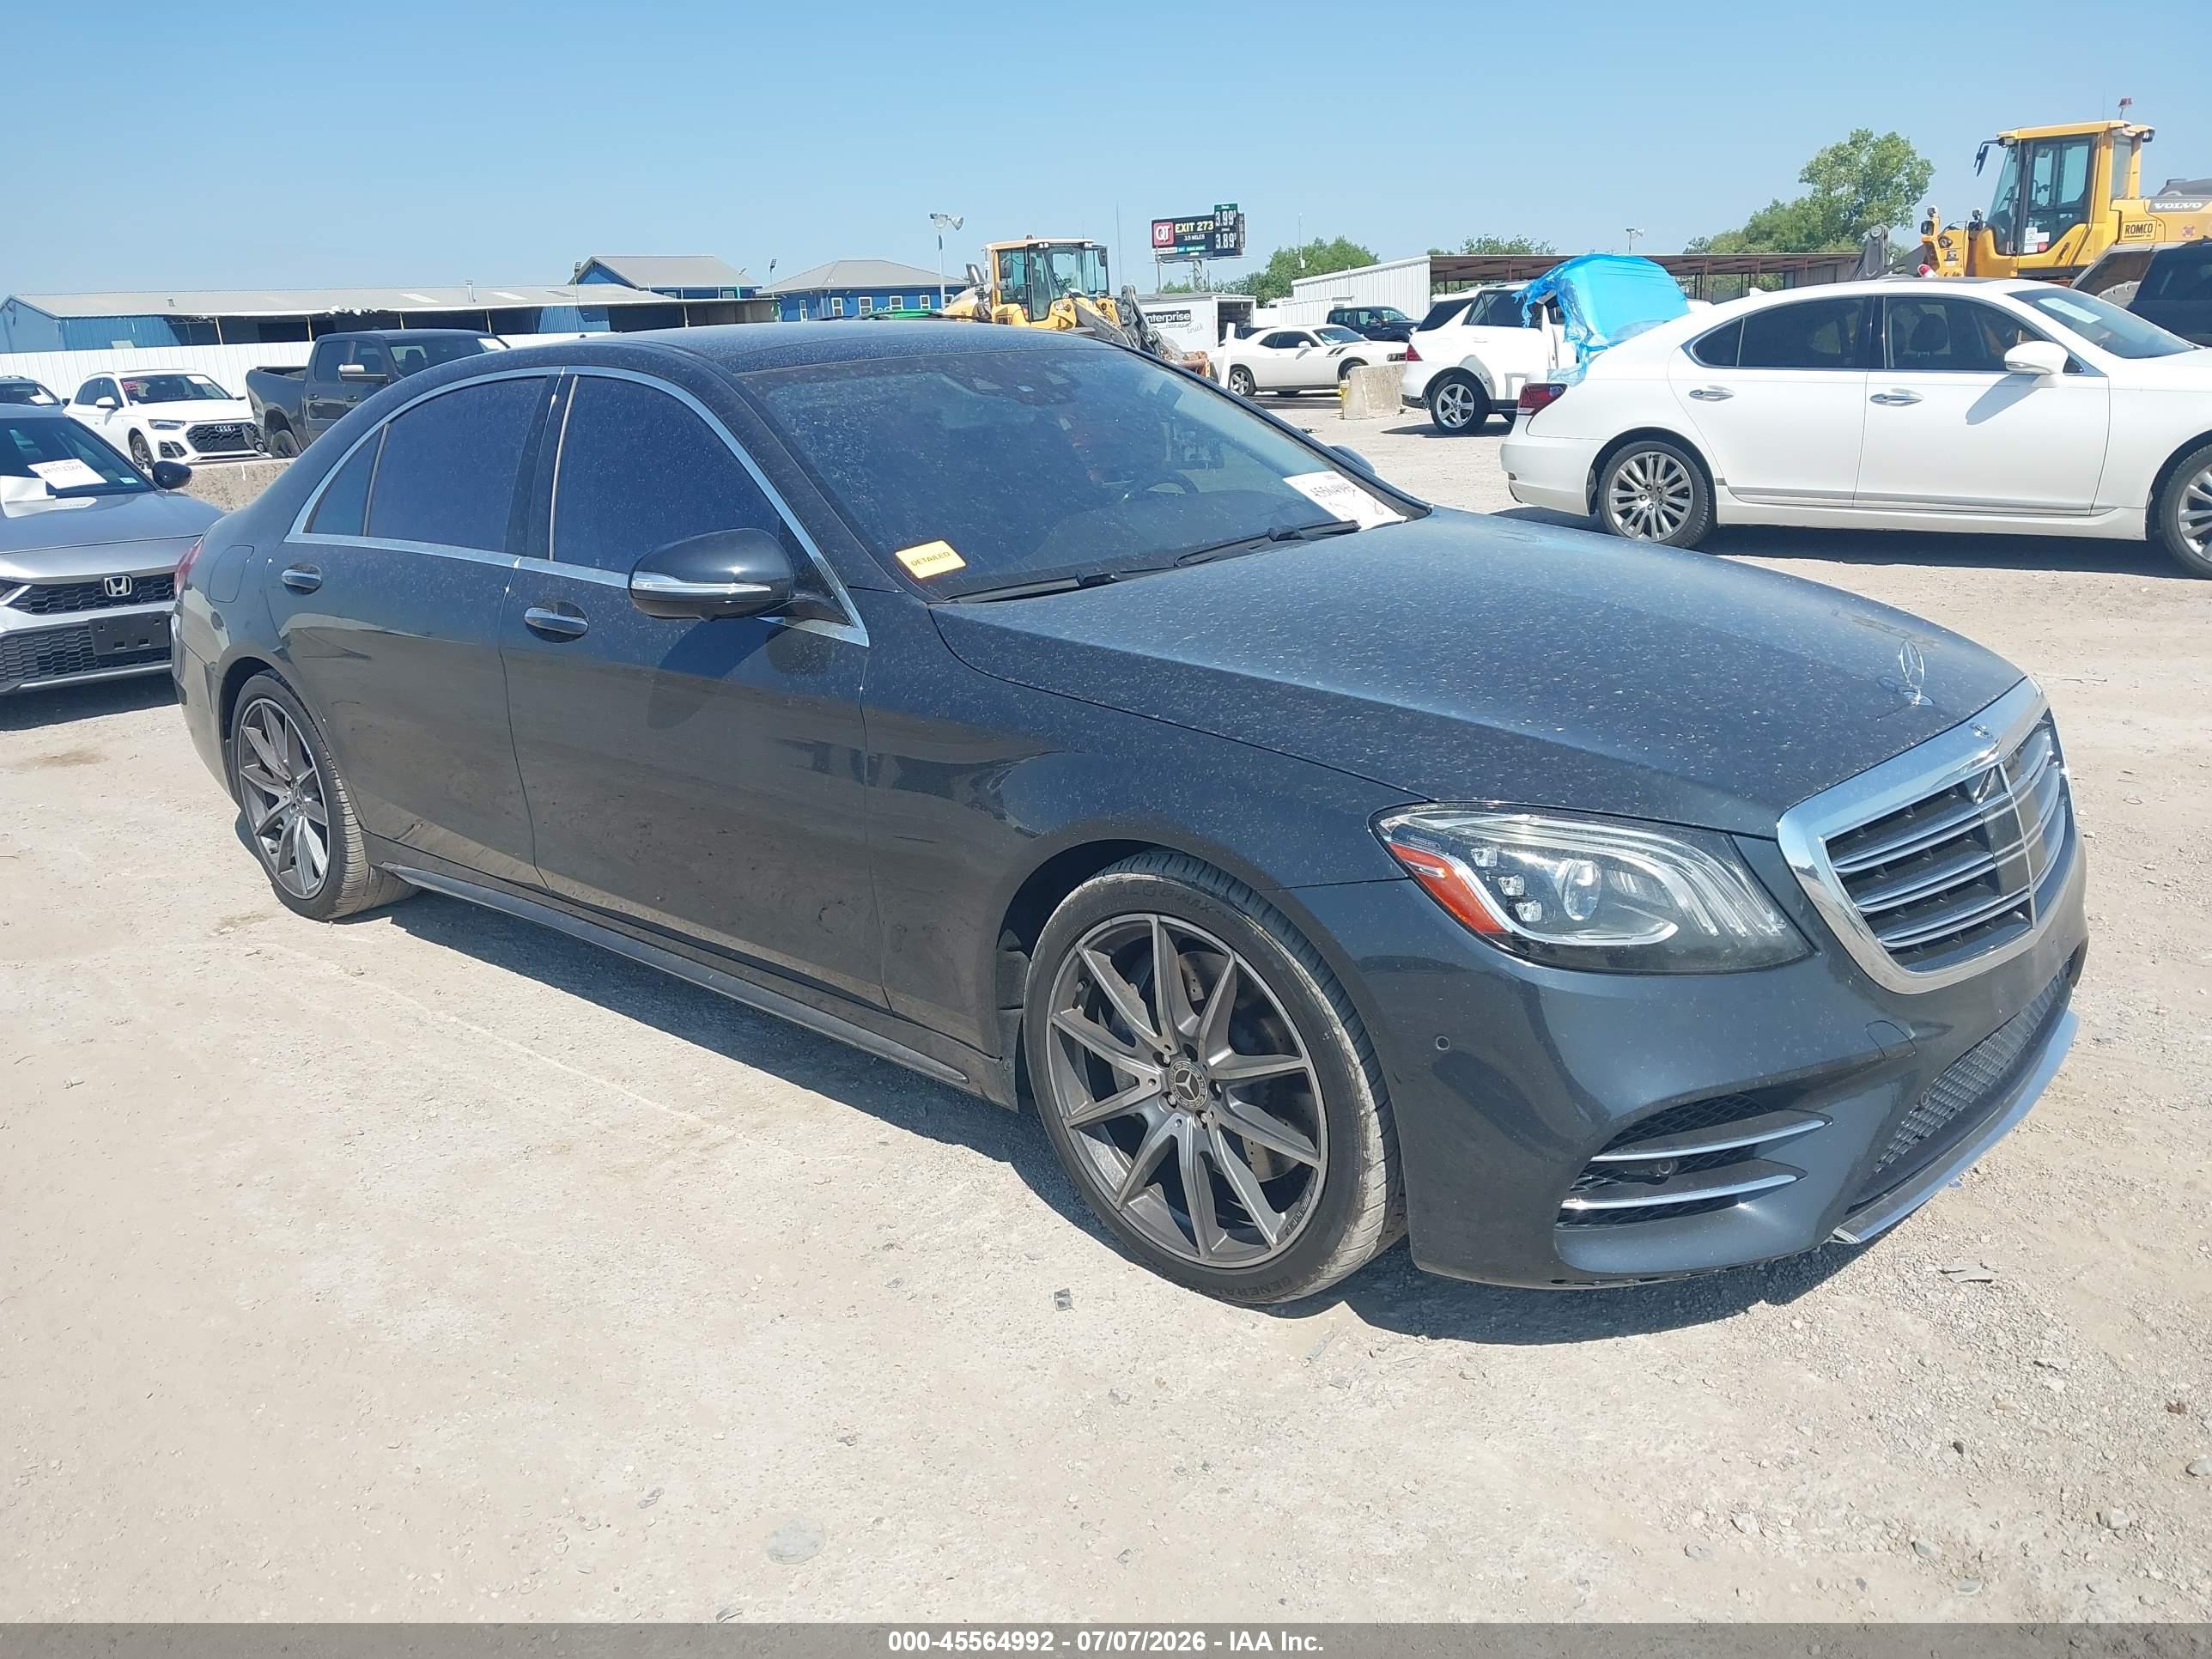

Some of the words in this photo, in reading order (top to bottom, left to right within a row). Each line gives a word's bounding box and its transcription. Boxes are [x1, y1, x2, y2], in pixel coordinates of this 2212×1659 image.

[1175, 222, 1194, 233] EXIT
[1196, 220, 1214, 232] 273
[2125, 223, 2153, 234] ROMCO
[1155, 225, 1170, 242] QT
[1144, 311, 1191, 324] nterprise
[910, 551, 951, 567] DETAILED
